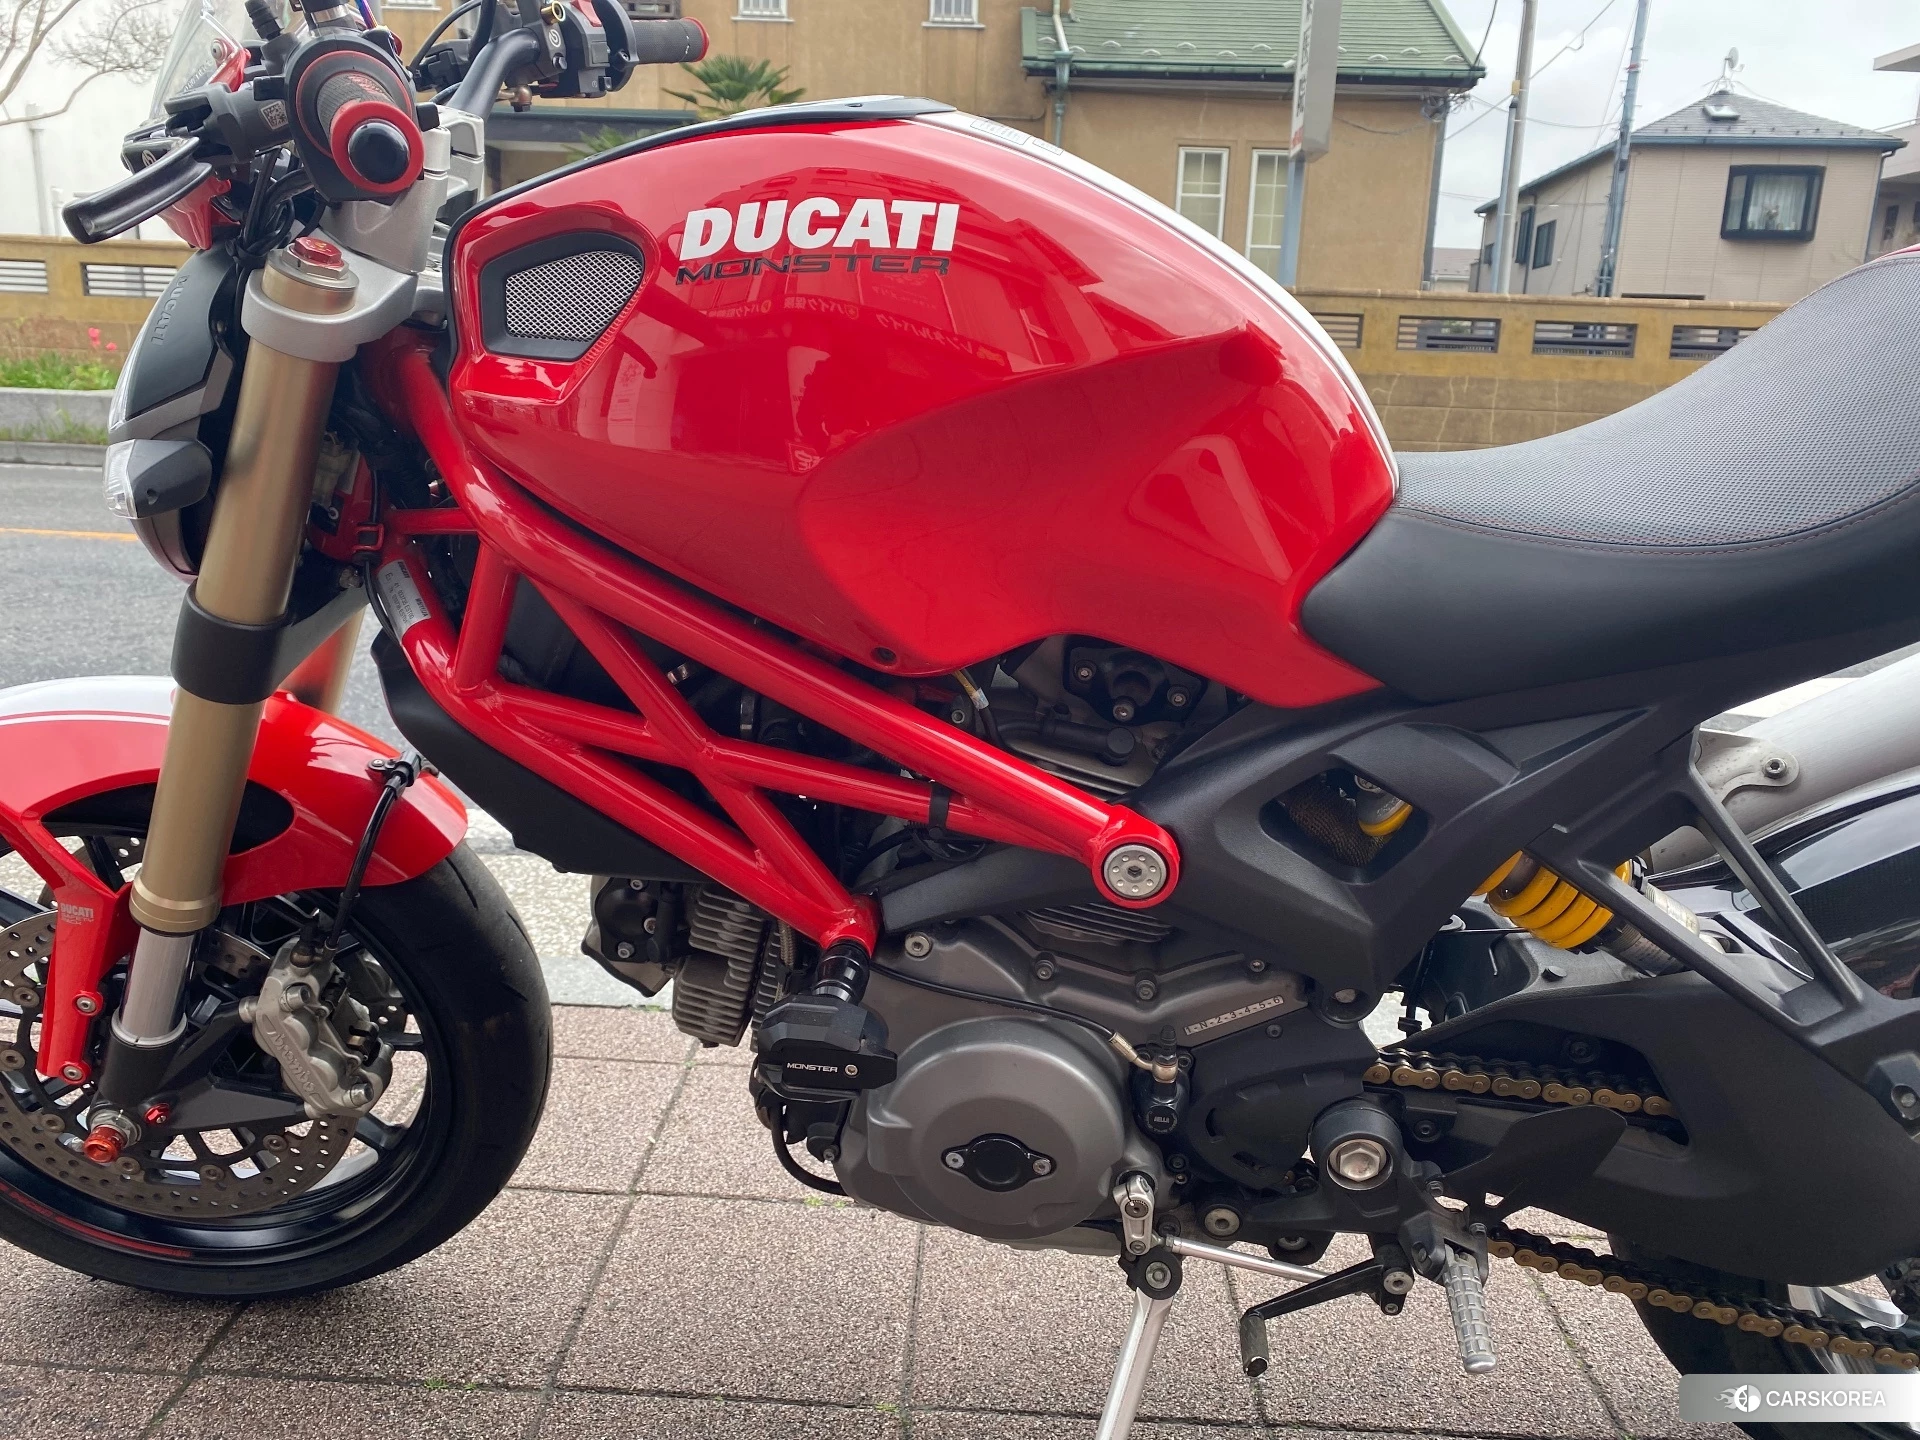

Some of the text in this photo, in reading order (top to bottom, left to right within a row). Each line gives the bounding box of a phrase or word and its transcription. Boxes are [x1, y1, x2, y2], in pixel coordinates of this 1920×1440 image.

[679, 197, 960, 261] DUCATI
[675, 253, 951, 285] MONSTER
[151, 275, 190, 346] DUCATI
[60, 902, 94, 918] DUCATI
[271, 1033, 315, 1092] brembo
[786, 1062, 838, 1073] MONSTER
